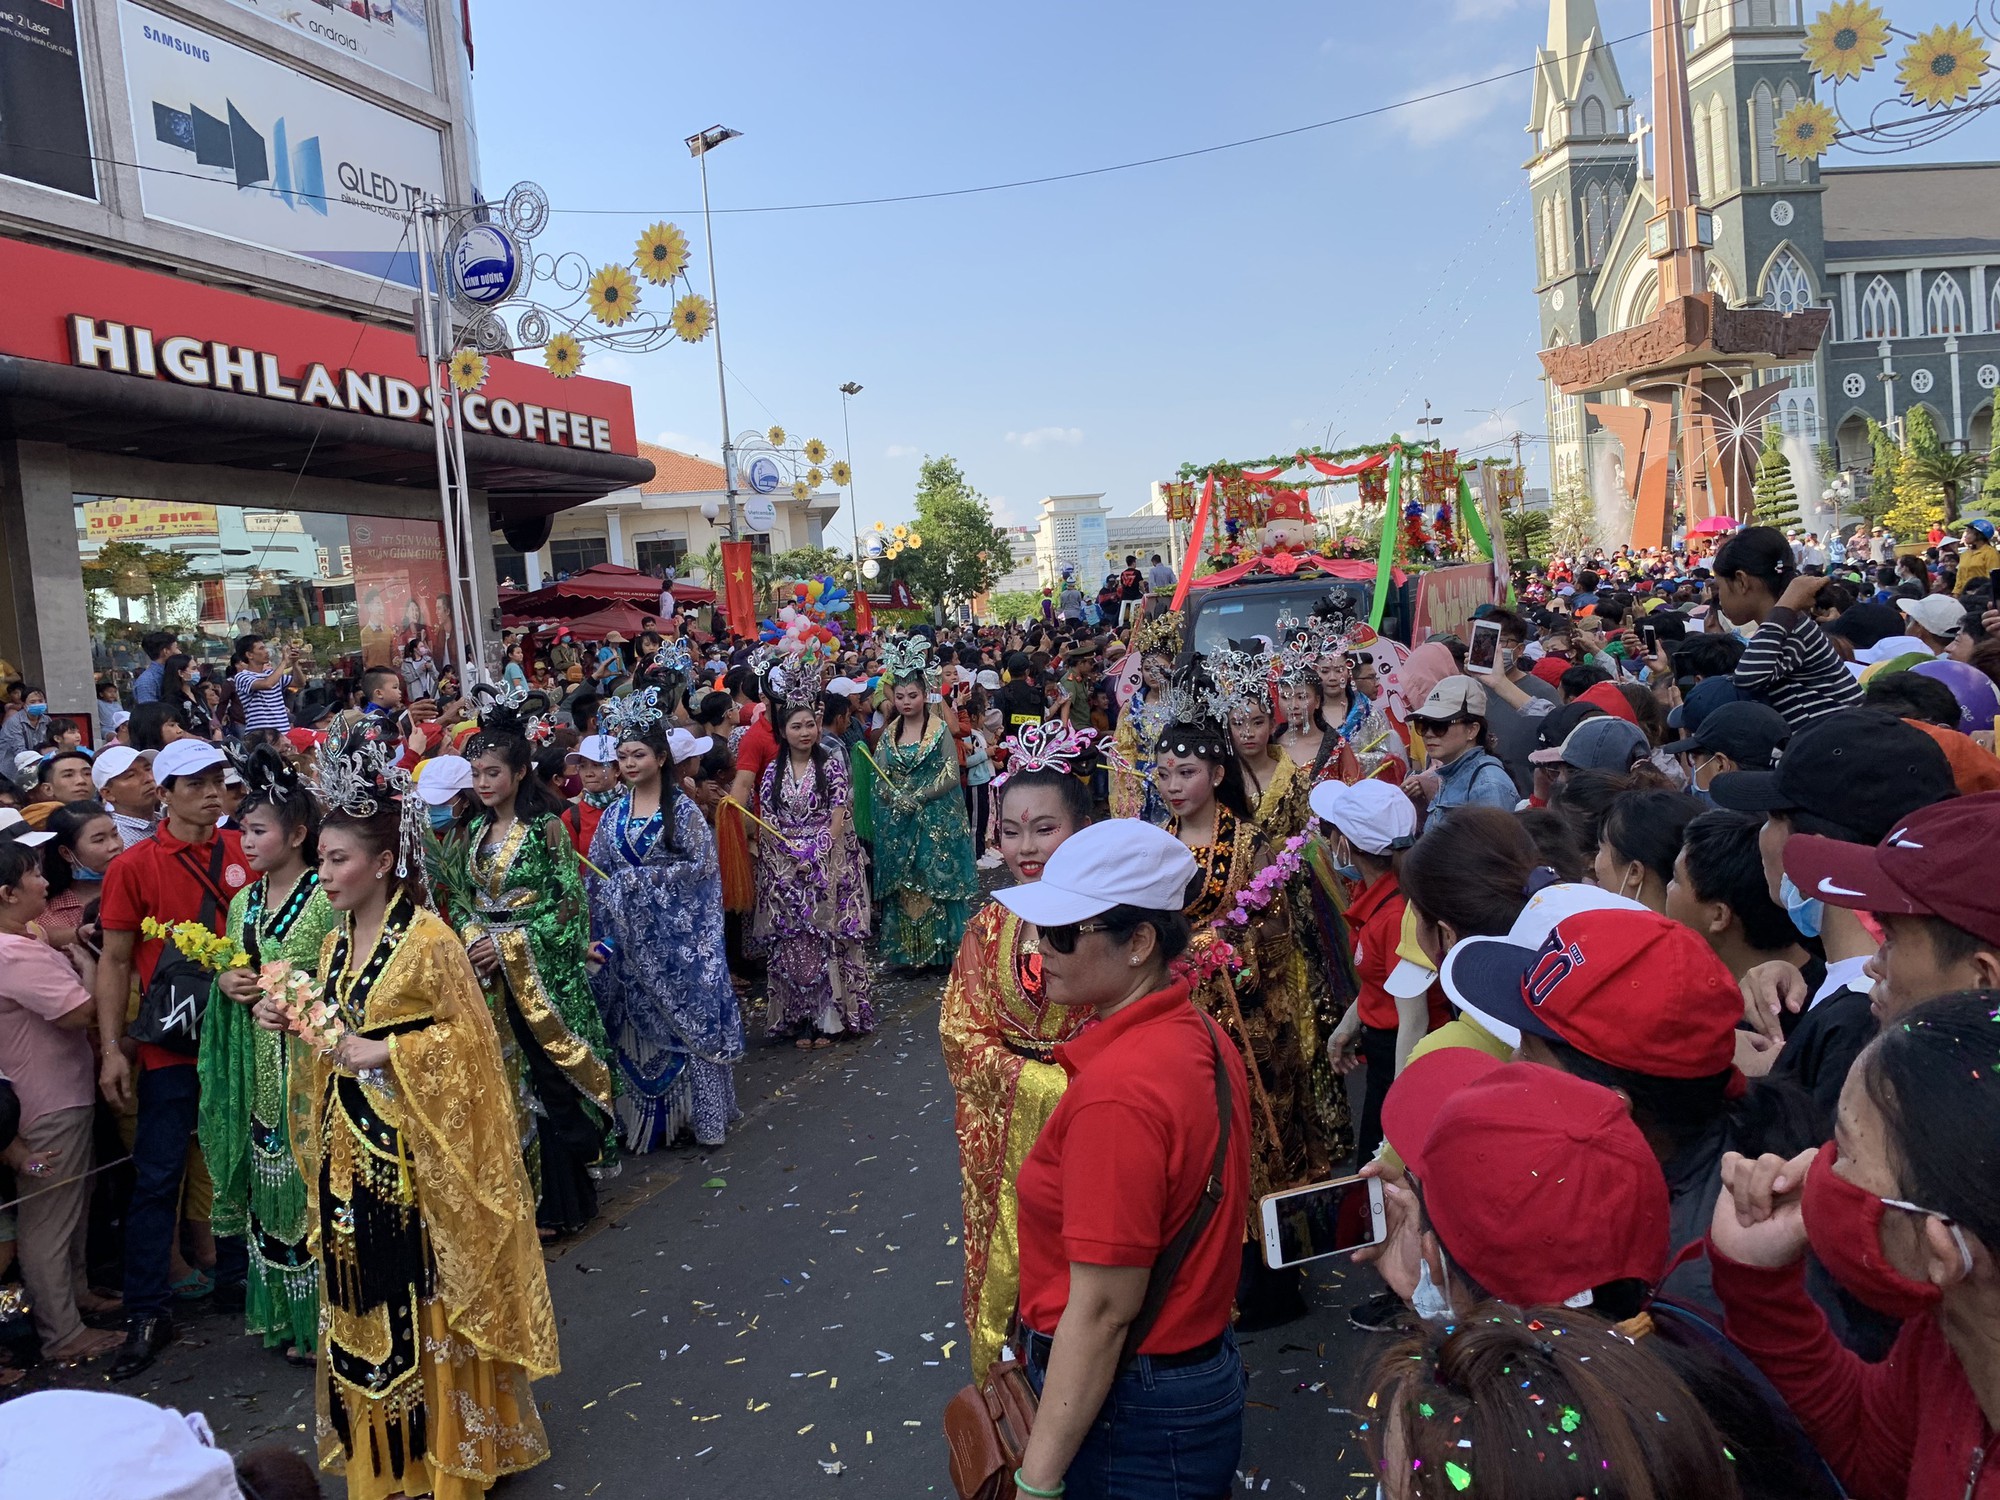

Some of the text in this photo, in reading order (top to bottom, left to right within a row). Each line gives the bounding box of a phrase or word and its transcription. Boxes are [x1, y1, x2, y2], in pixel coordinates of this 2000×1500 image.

[17, 14, 24, 26] 2
[26, 18, 50, 35] Laser
[143, 25, 210, 63] SAMSUNG
[338, 162, 398, 205] QLED
[464, 274, 480, 288] BÌNH
[74, 314, 611, 451] HIGHLANDS COFFEE
[395, 534, 414, 546] SEN
[416, 533, 441, 547] VÀNG
